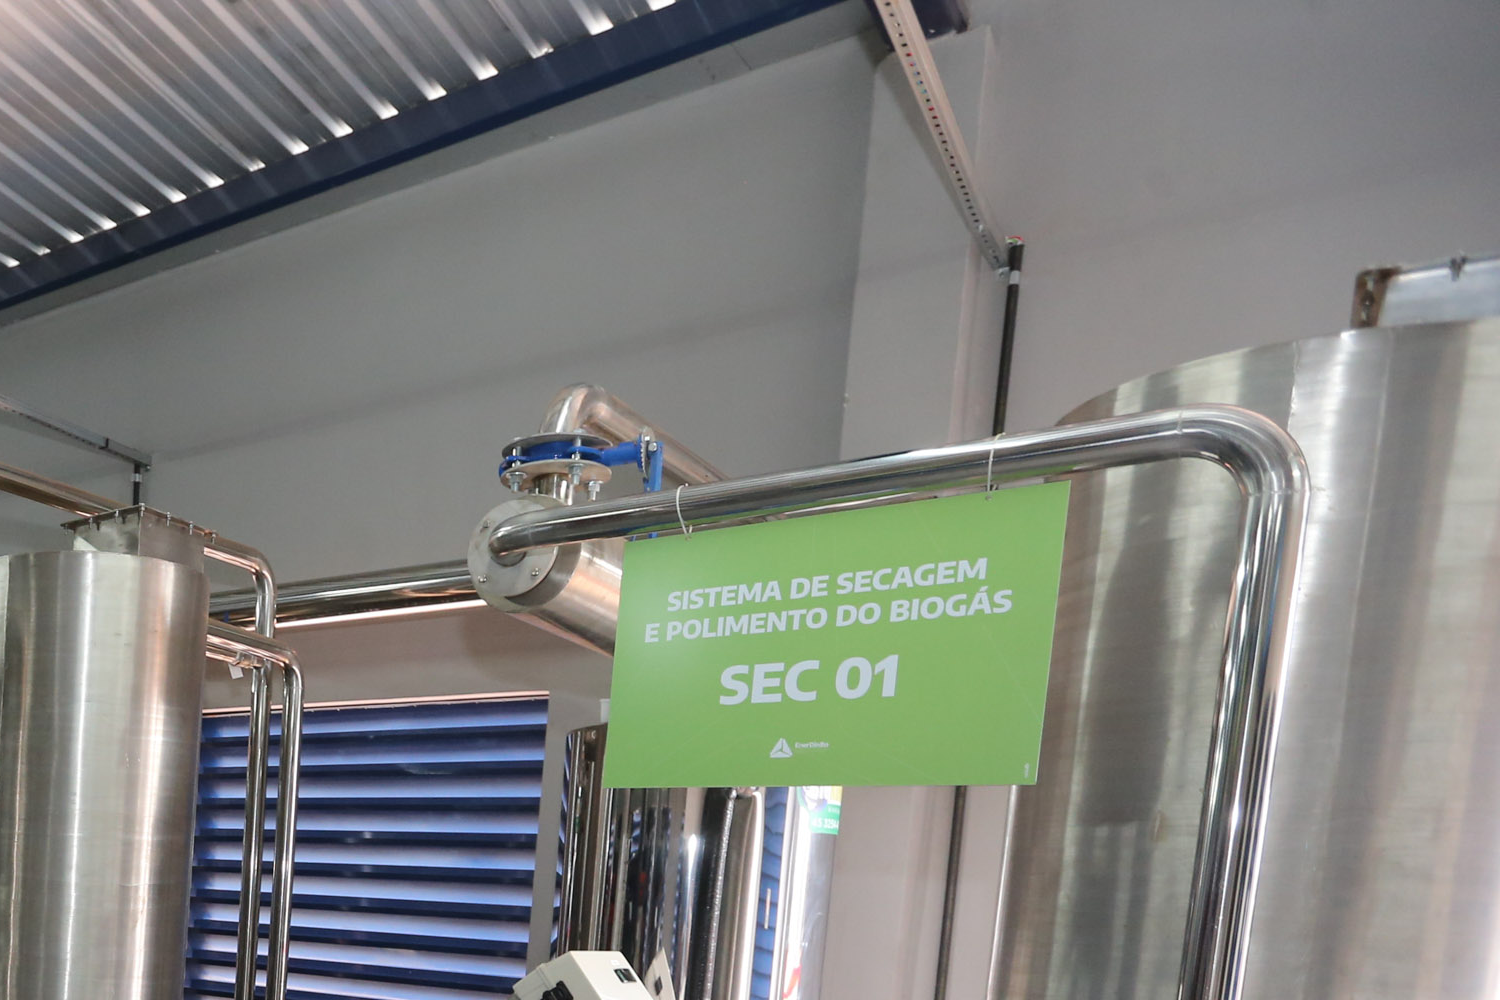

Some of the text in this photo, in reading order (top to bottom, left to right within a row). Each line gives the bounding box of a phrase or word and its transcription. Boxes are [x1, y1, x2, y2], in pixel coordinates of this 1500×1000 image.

[666, 557, 988, 612] SISTEMA DE SECAGEM
[645, 586, 1013, 643] E POLIMENTO DO BIOGÁS
[719, 654, 899, 706] SEC 01
